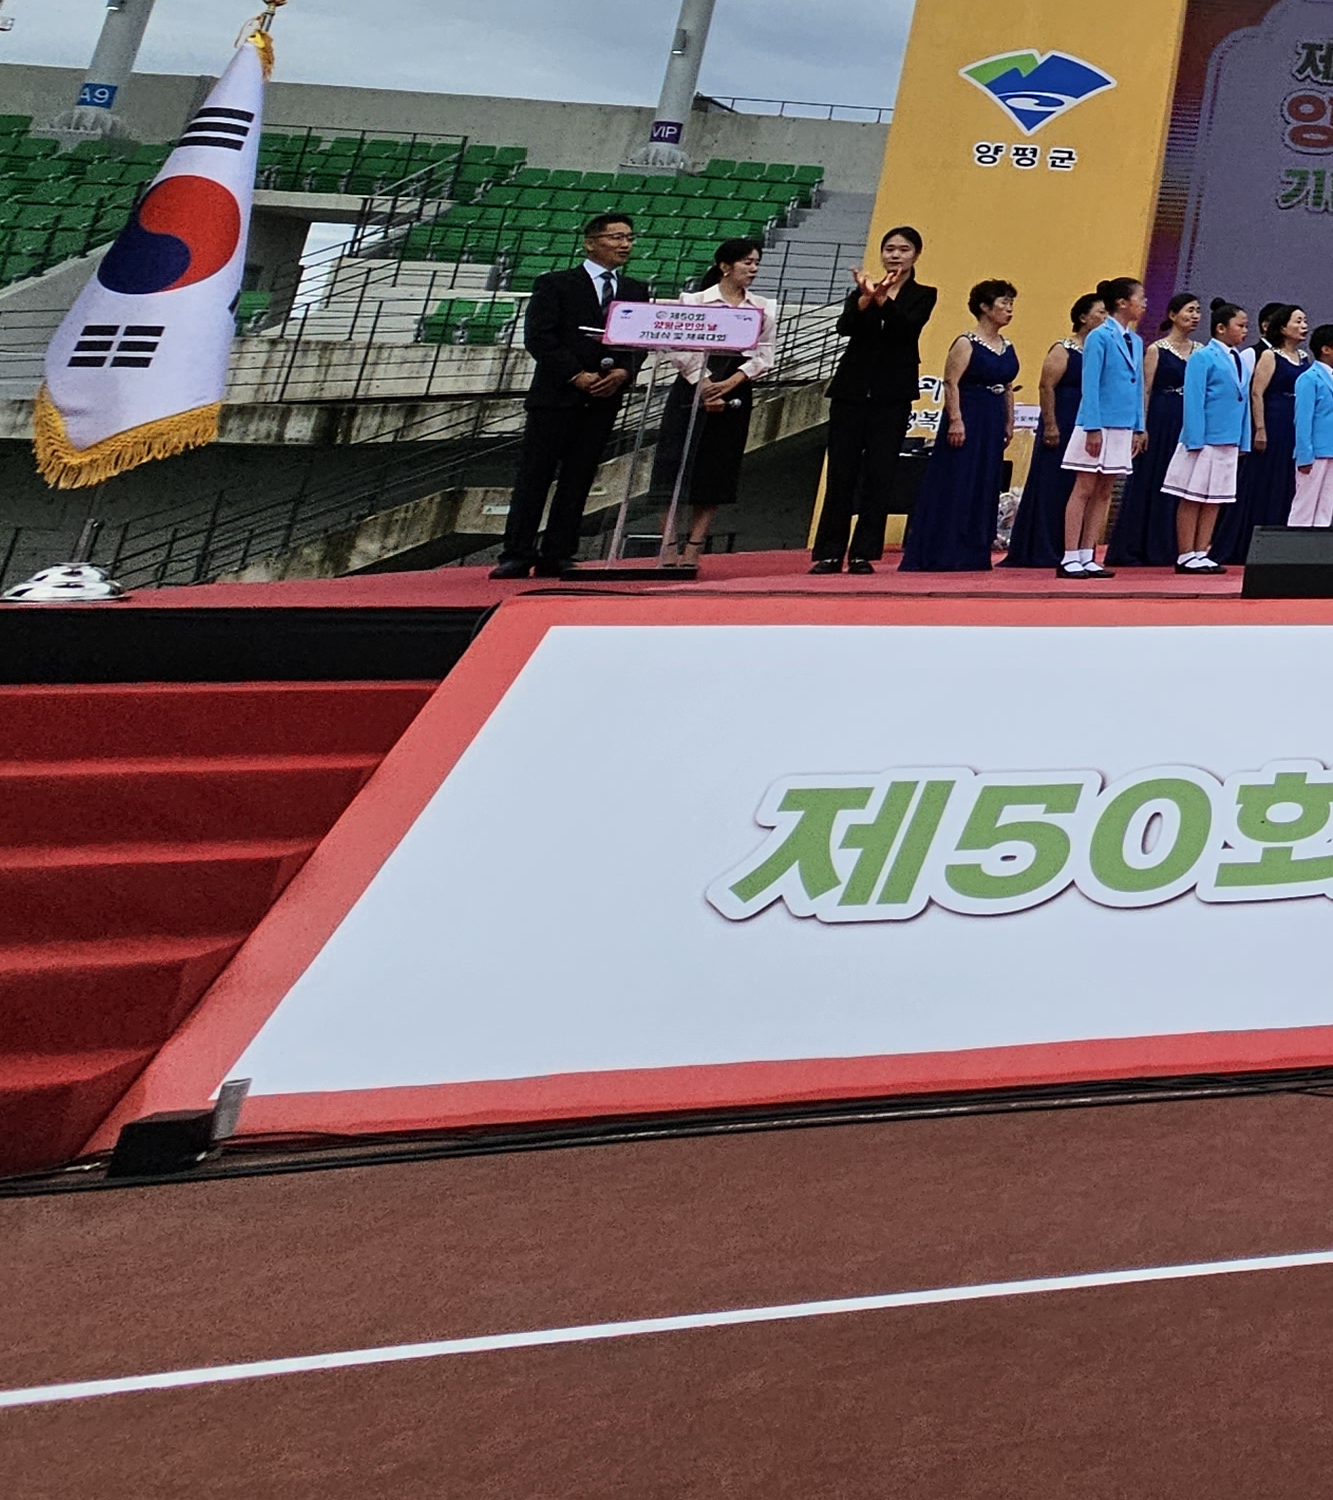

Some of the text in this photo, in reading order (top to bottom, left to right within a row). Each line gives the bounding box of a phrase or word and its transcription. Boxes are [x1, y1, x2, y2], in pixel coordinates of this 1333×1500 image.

[80, 87, 109, 103] A9
[652, 125, 678, 138] VIP
[974, 143, 1077, 170] 양평군
